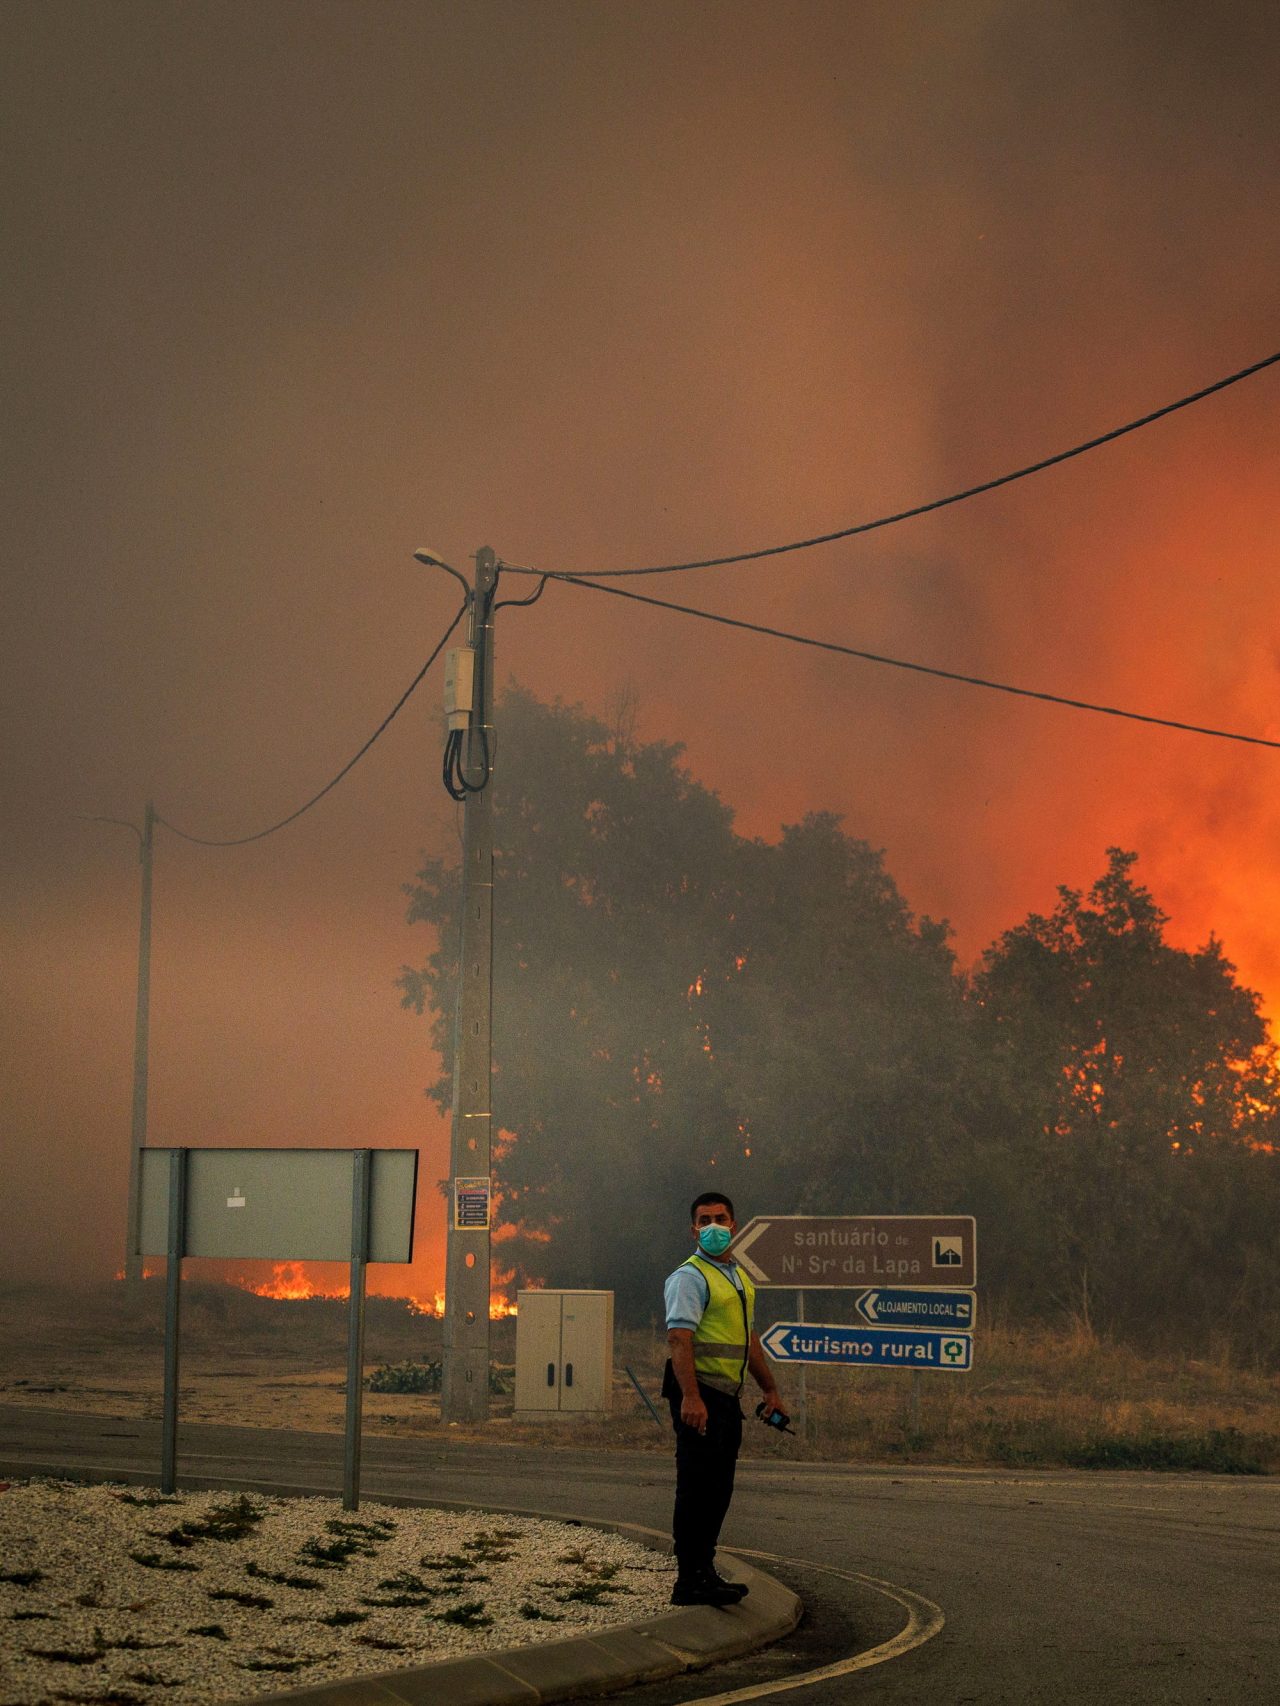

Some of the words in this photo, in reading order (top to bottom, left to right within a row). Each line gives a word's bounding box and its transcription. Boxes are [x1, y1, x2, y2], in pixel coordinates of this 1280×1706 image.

[794, 1228, 889, 1246] santuário
[895, 1235, 909, 1246] de
[842, 1256, 866, 1274] da
[873, 1256, 921, 1277] Lapa
[877, 1302, 928, 1314] ALOJAMENTO
[929, 1303, 955, 1316] LOCAL
[791, 1335, 873, 1357] turismo
[881, 1341, 933, 1360] rural
